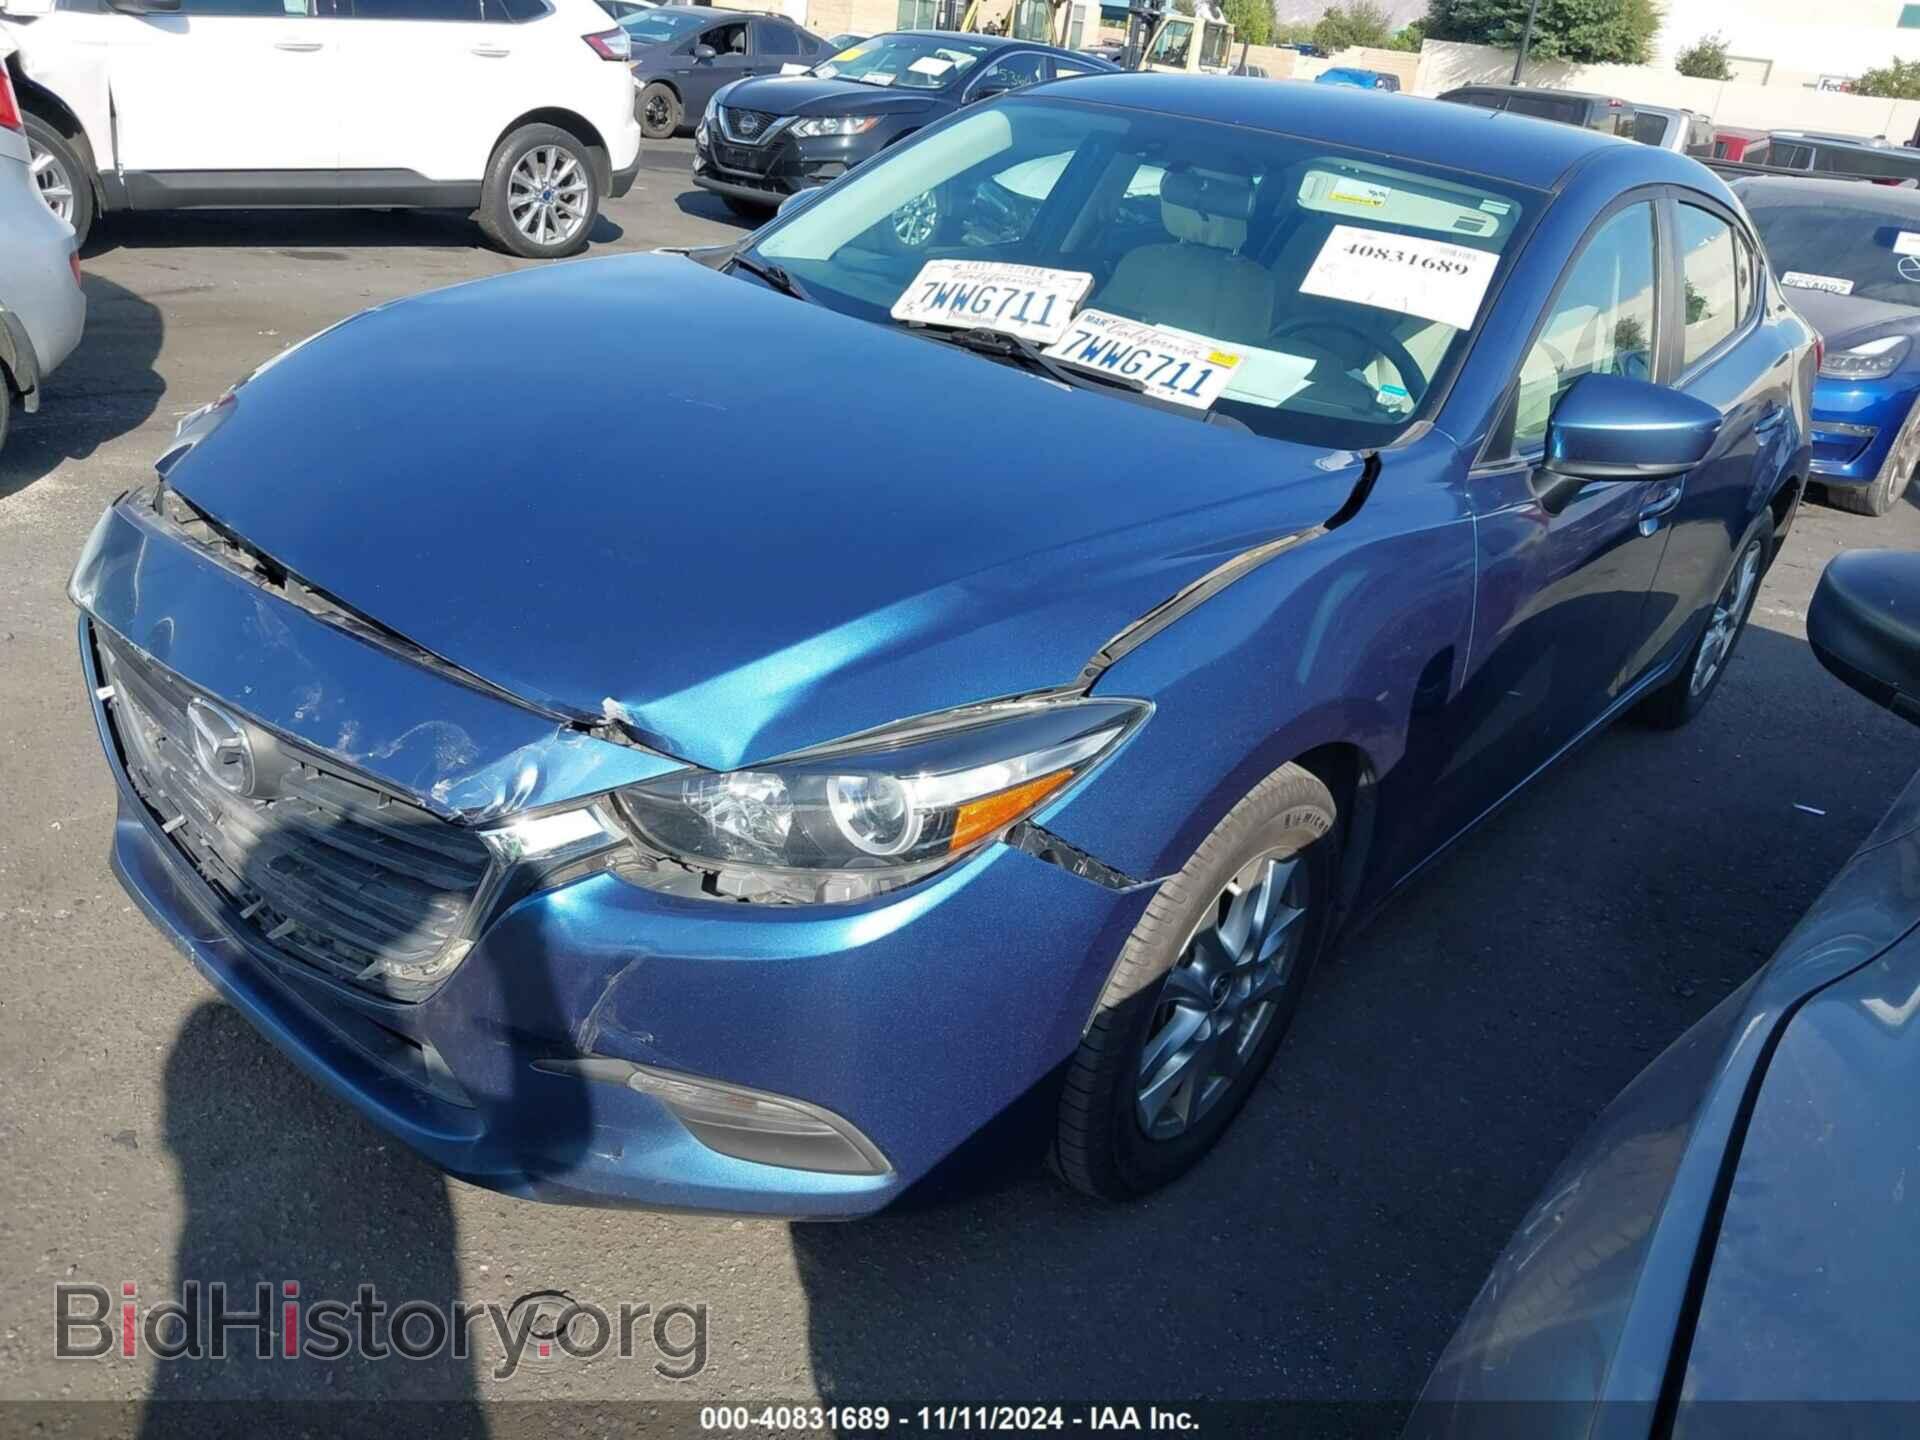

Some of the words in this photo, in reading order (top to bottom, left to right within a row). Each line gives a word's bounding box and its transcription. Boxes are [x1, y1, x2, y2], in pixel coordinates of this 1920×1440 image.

[1343, 243, 1469, 276] 40831689
[920, 282, 1057, 328] 7WWG711
[1106, 322, 1201, 359] California
[1061, 329, 1214, 398] 7WWG711
